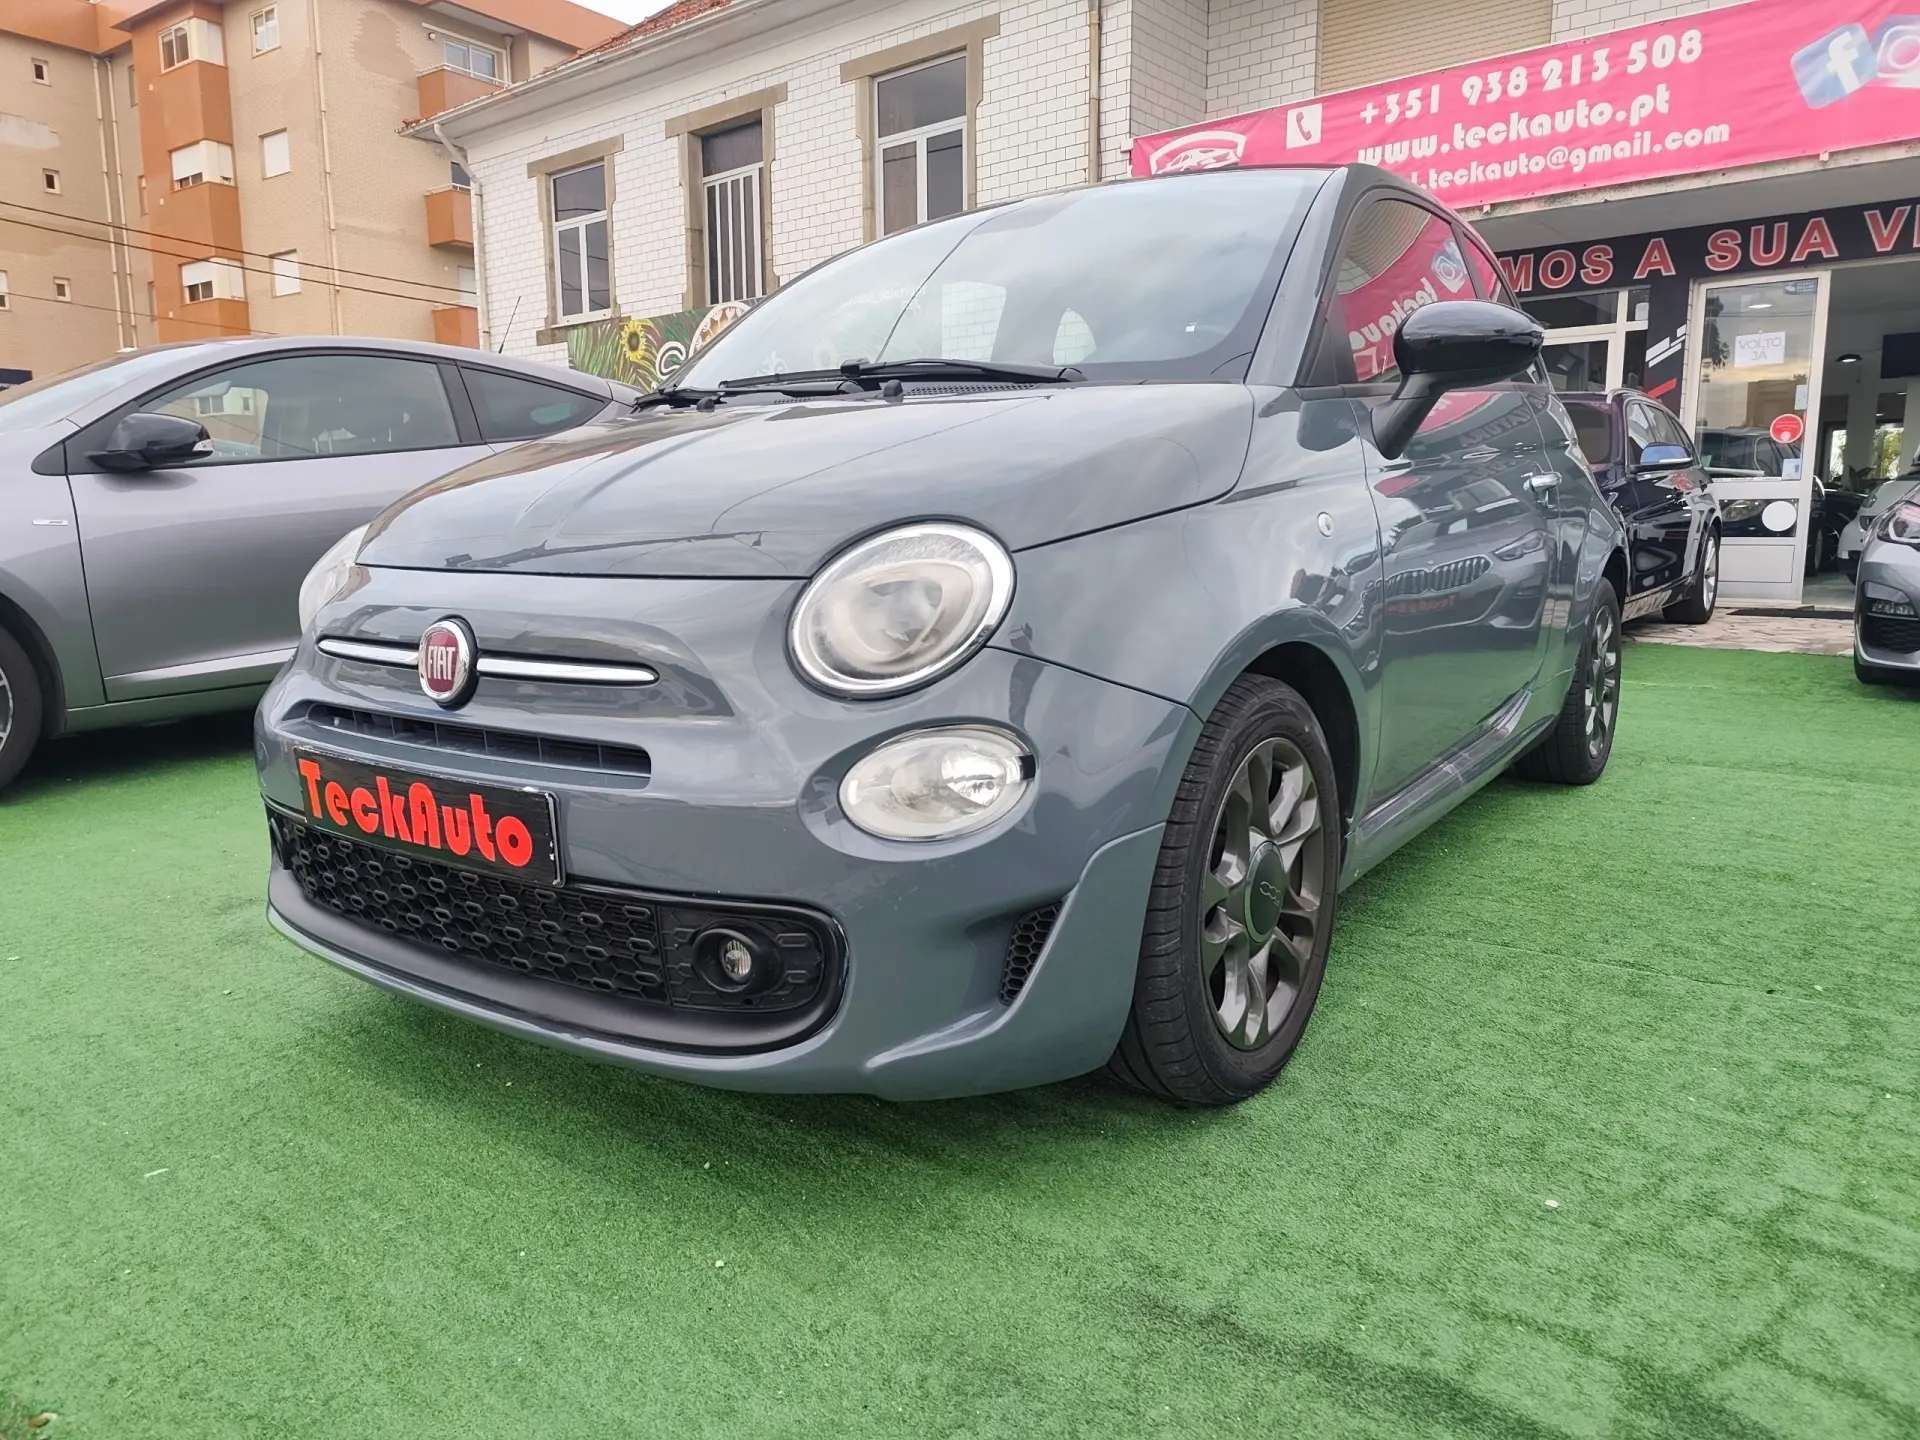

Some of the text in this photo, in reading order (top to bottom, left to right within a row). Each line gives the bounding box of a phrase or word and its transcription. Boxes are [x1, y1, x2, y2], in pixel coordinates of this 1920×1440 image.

[1359, 29, 1702, 124] +351 938 213 508
[1357, 83, 1670, 167] www.teckauto.pt
[1633, 237, 1676, 279] A
[1704, 217, 1839, 272] SUA
[1738, 337, 1782, 350] VOLTO
[427, 645, 456, 681] FIAT
[298, 758, 533, 868] TeckAuto
